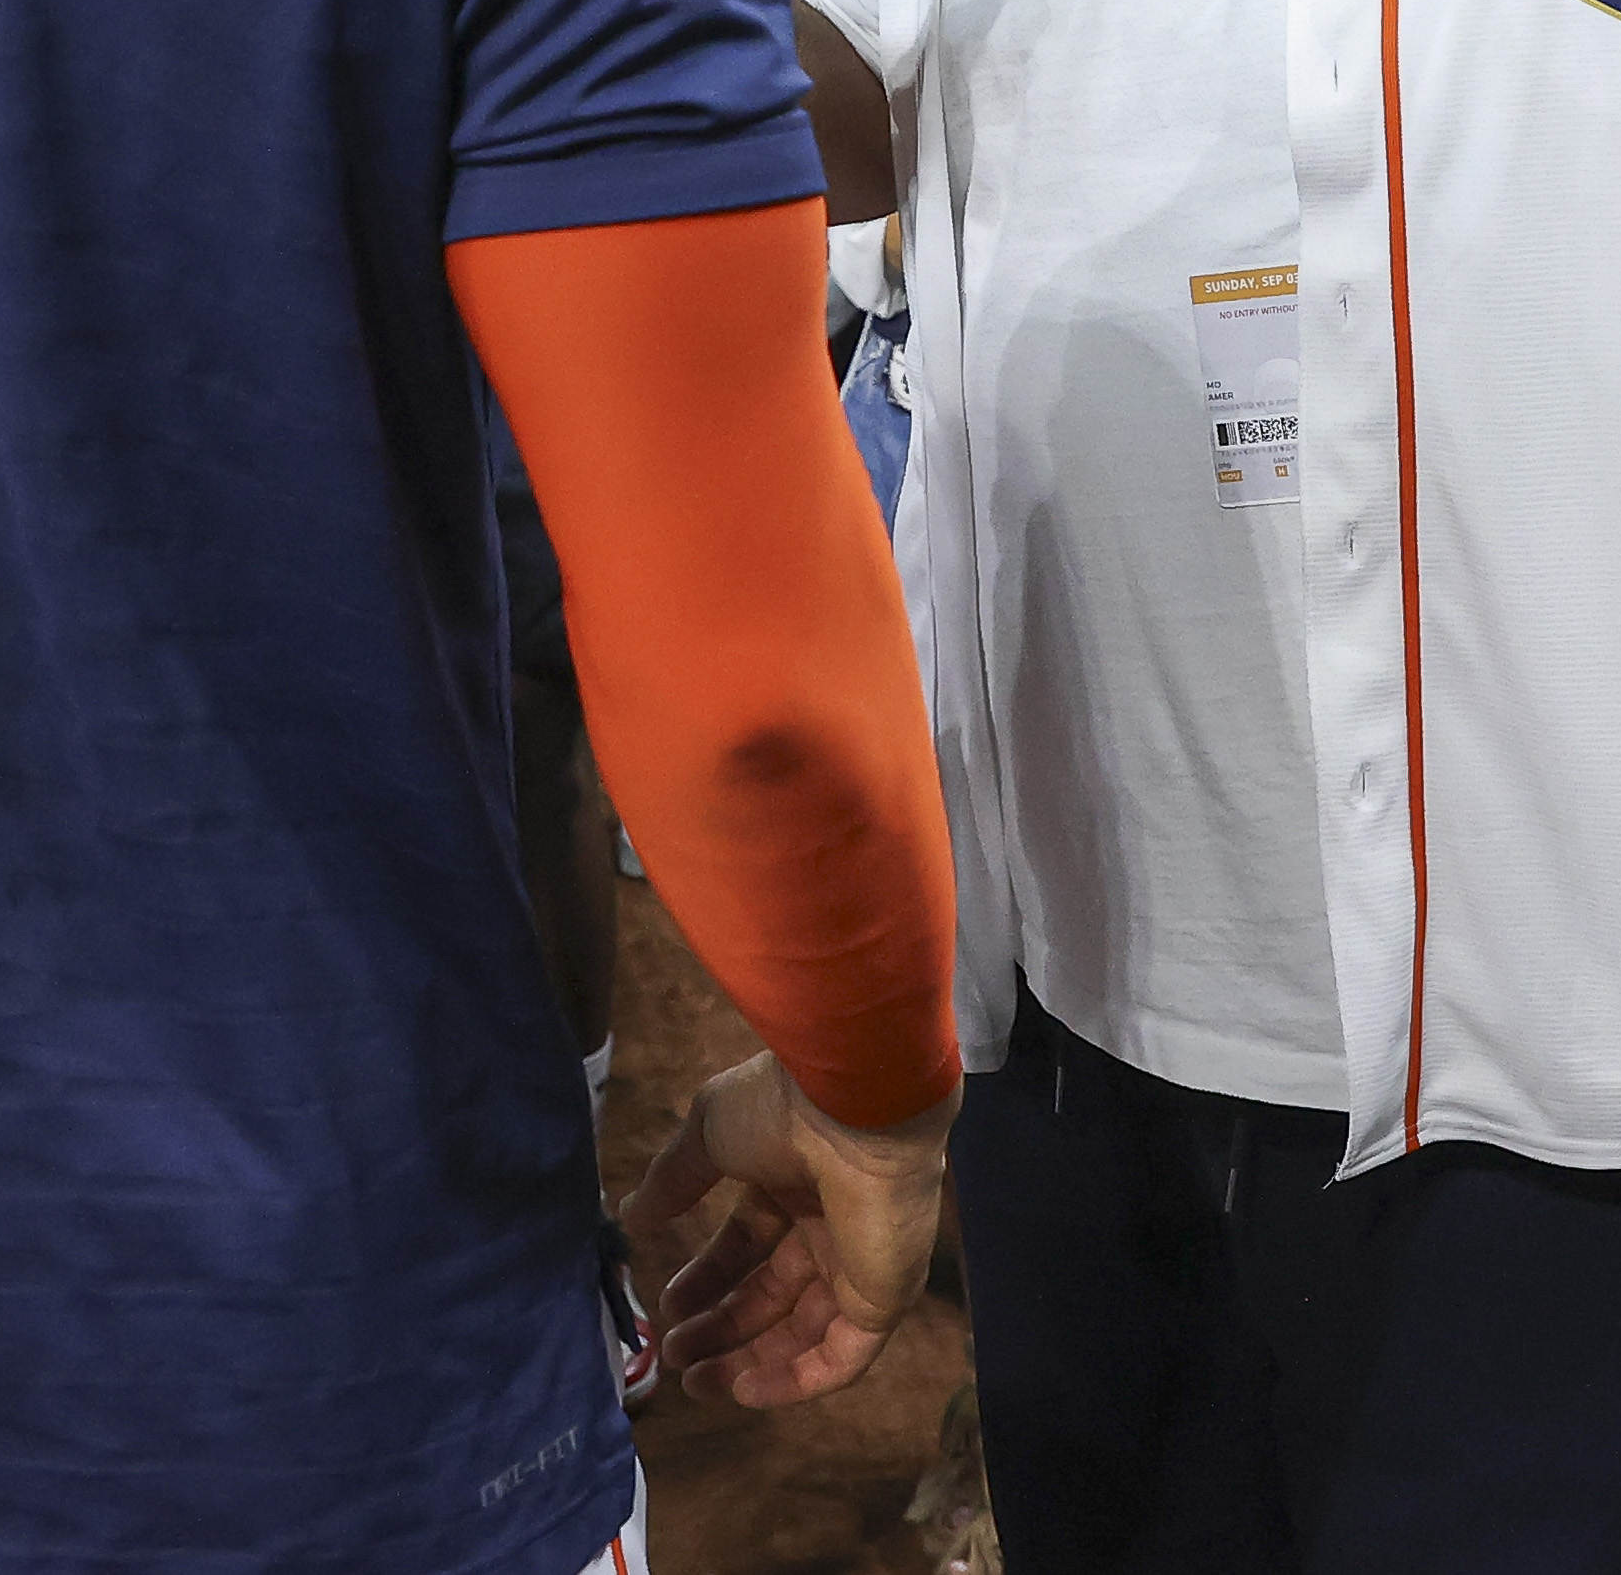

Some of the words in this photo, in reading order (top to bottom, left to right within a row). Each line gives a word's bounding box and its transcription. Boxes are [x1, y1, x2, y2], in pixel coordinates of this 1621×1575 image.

[1204, 276, 1259, 294] SUNDAY,
[1261, 274, 1284, 287] SEP
[1219, 310, 1233, 320] NO
[1234, 308, 1259, 319] ENTRY
[1208, 391, 1235, 402] AMER
